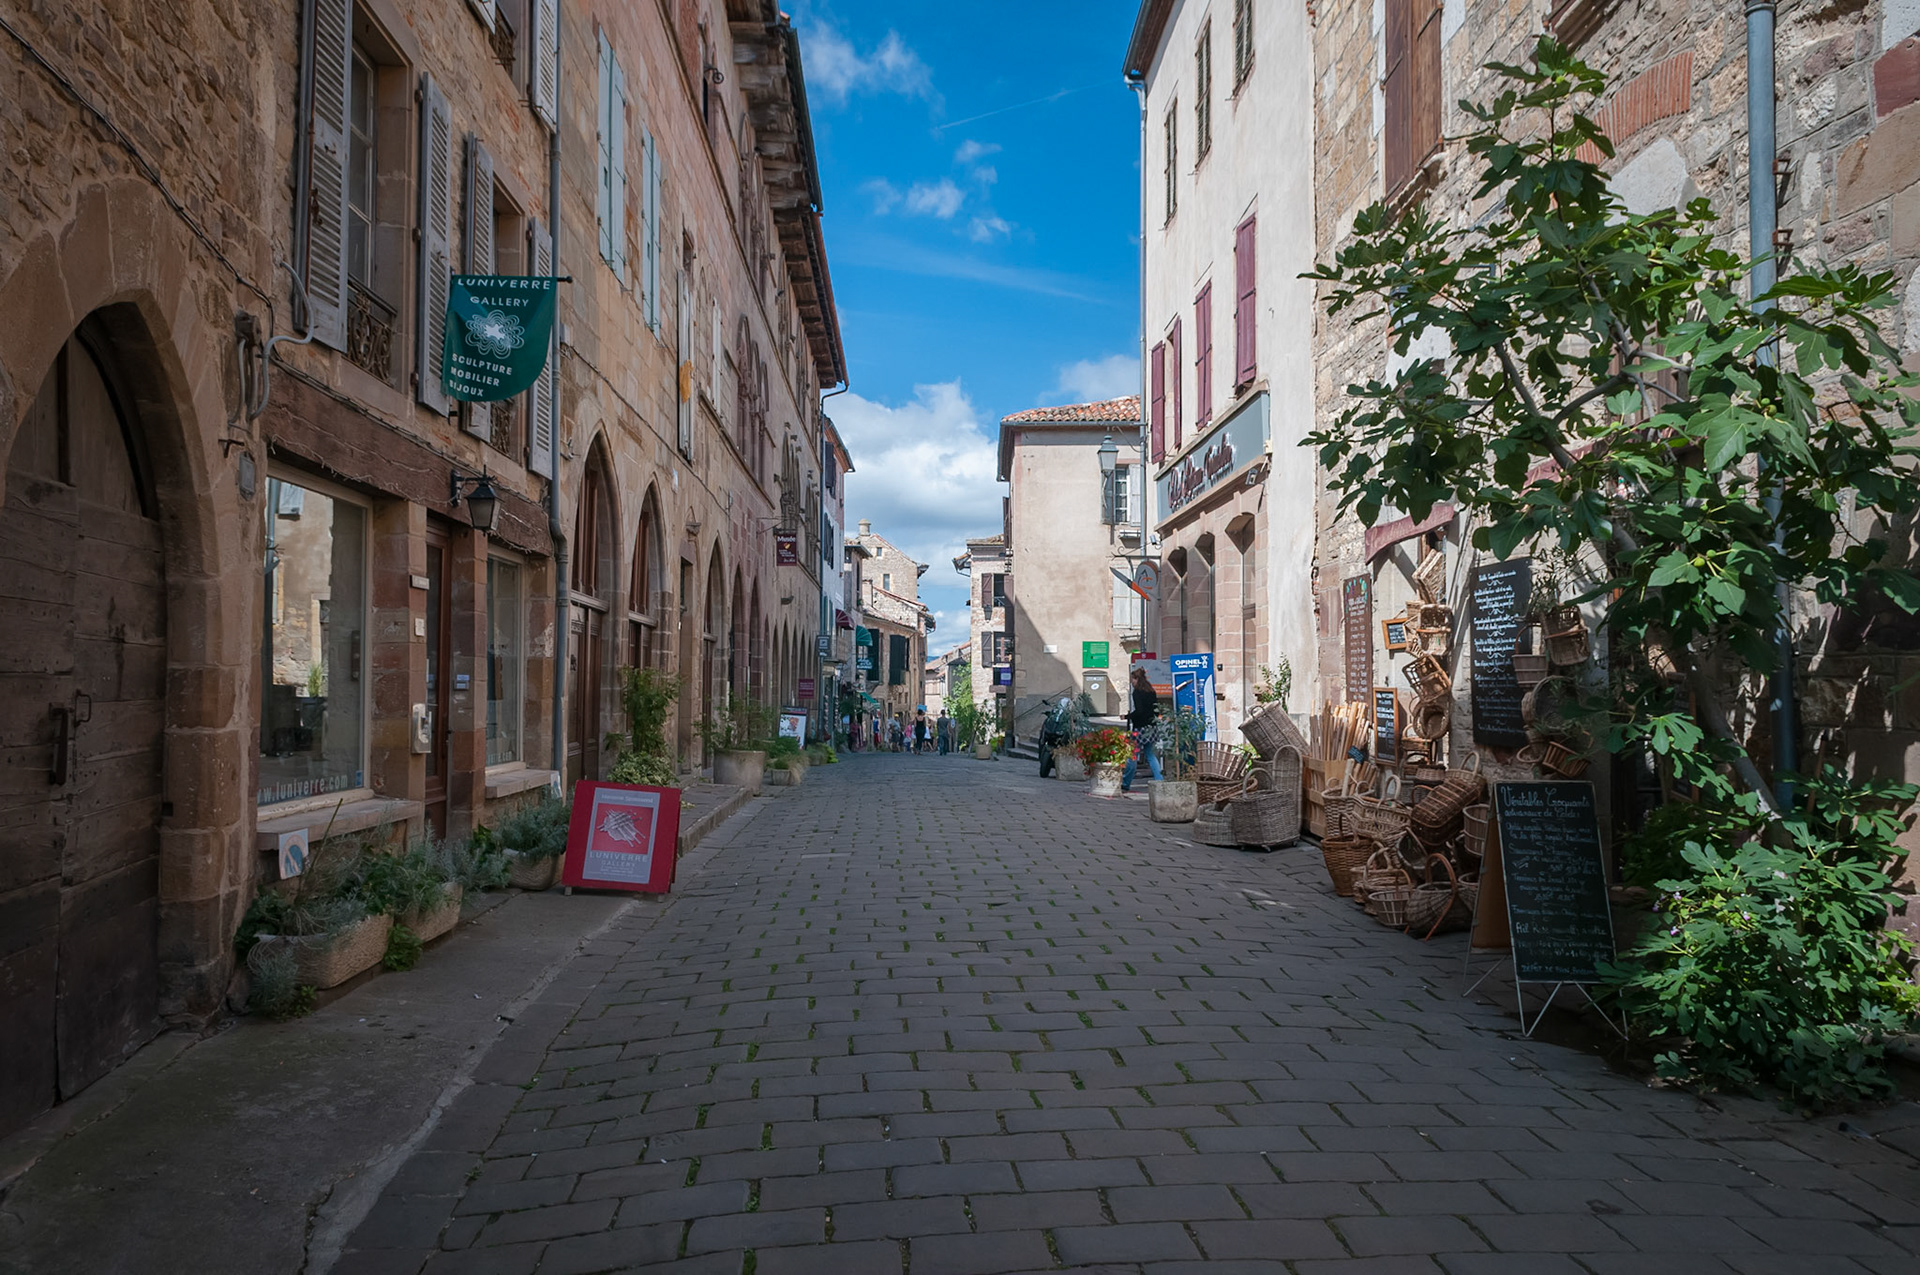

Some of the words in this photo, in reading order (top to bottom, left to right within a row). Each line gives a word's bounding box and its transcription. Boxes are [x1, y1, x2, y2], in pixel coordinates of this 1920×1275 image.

[470, 296, 530, 307] GALLERY
[452, 353, 513, 375] SCULPTURE
[450, 366, 500, 387] MOBILIER
[449, 379, 484, 397] BIJOUX
[777, 535, 796, 543] Musée
[601, 860, 636, 868] GALLERY
